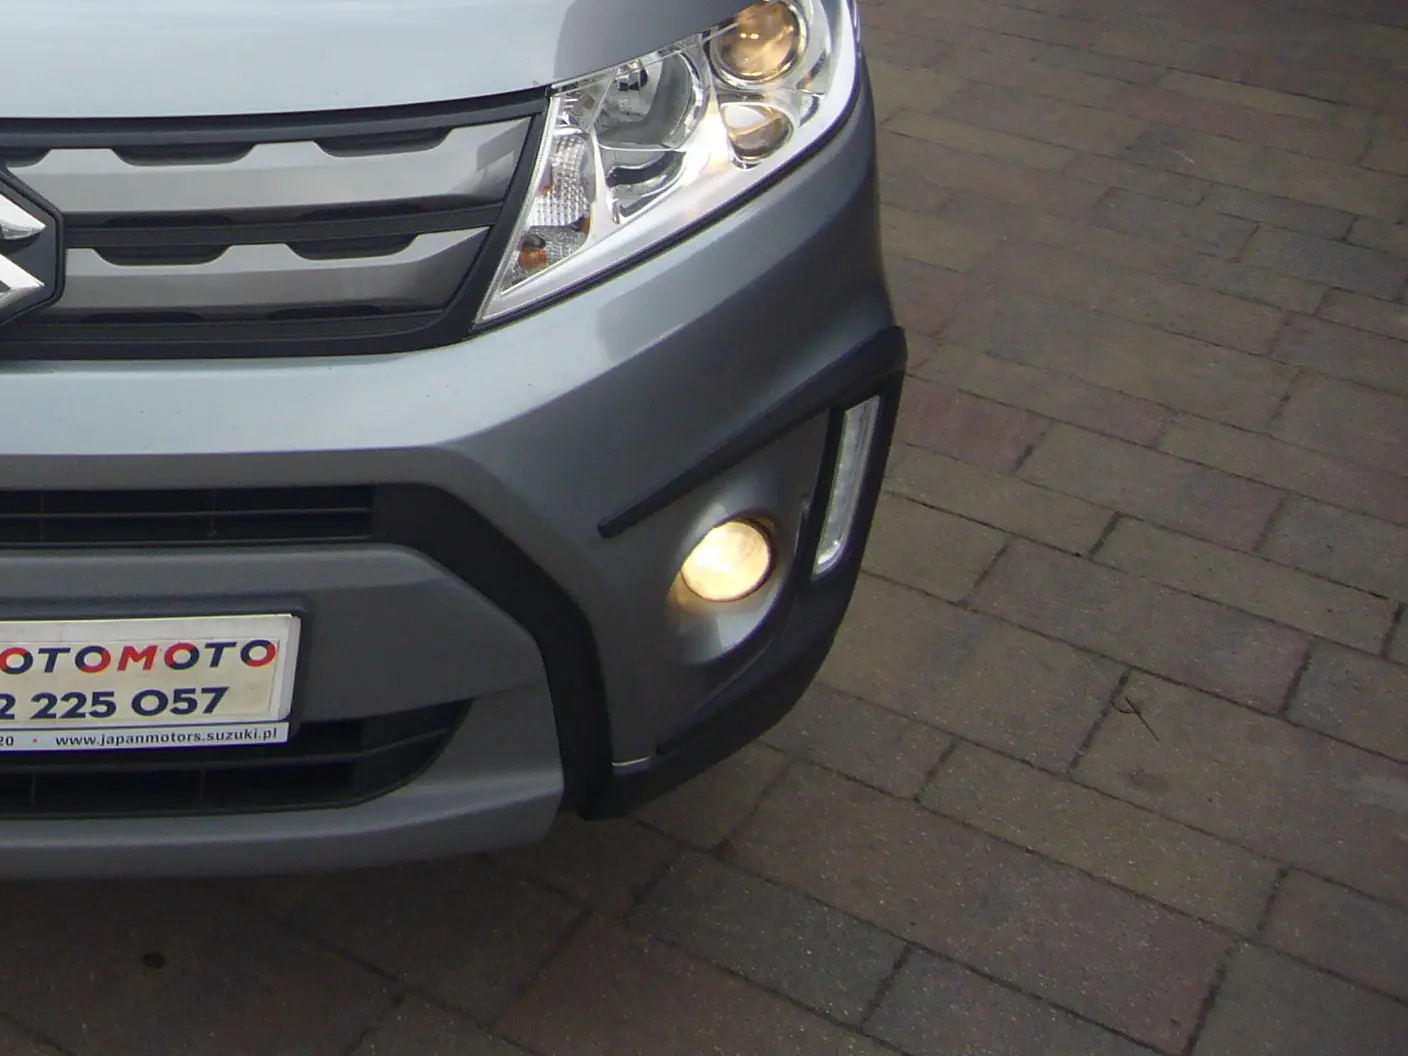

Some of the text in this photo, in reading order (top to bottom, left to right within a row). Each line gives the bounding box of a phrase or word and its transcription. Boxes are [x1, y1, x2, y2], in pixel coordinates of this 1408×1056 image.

[29, 691, 117, 719] 225
[131, 686, 230, 717] 057
[56, 727, 277, 747] www.japanmotors.suzuki.pl
